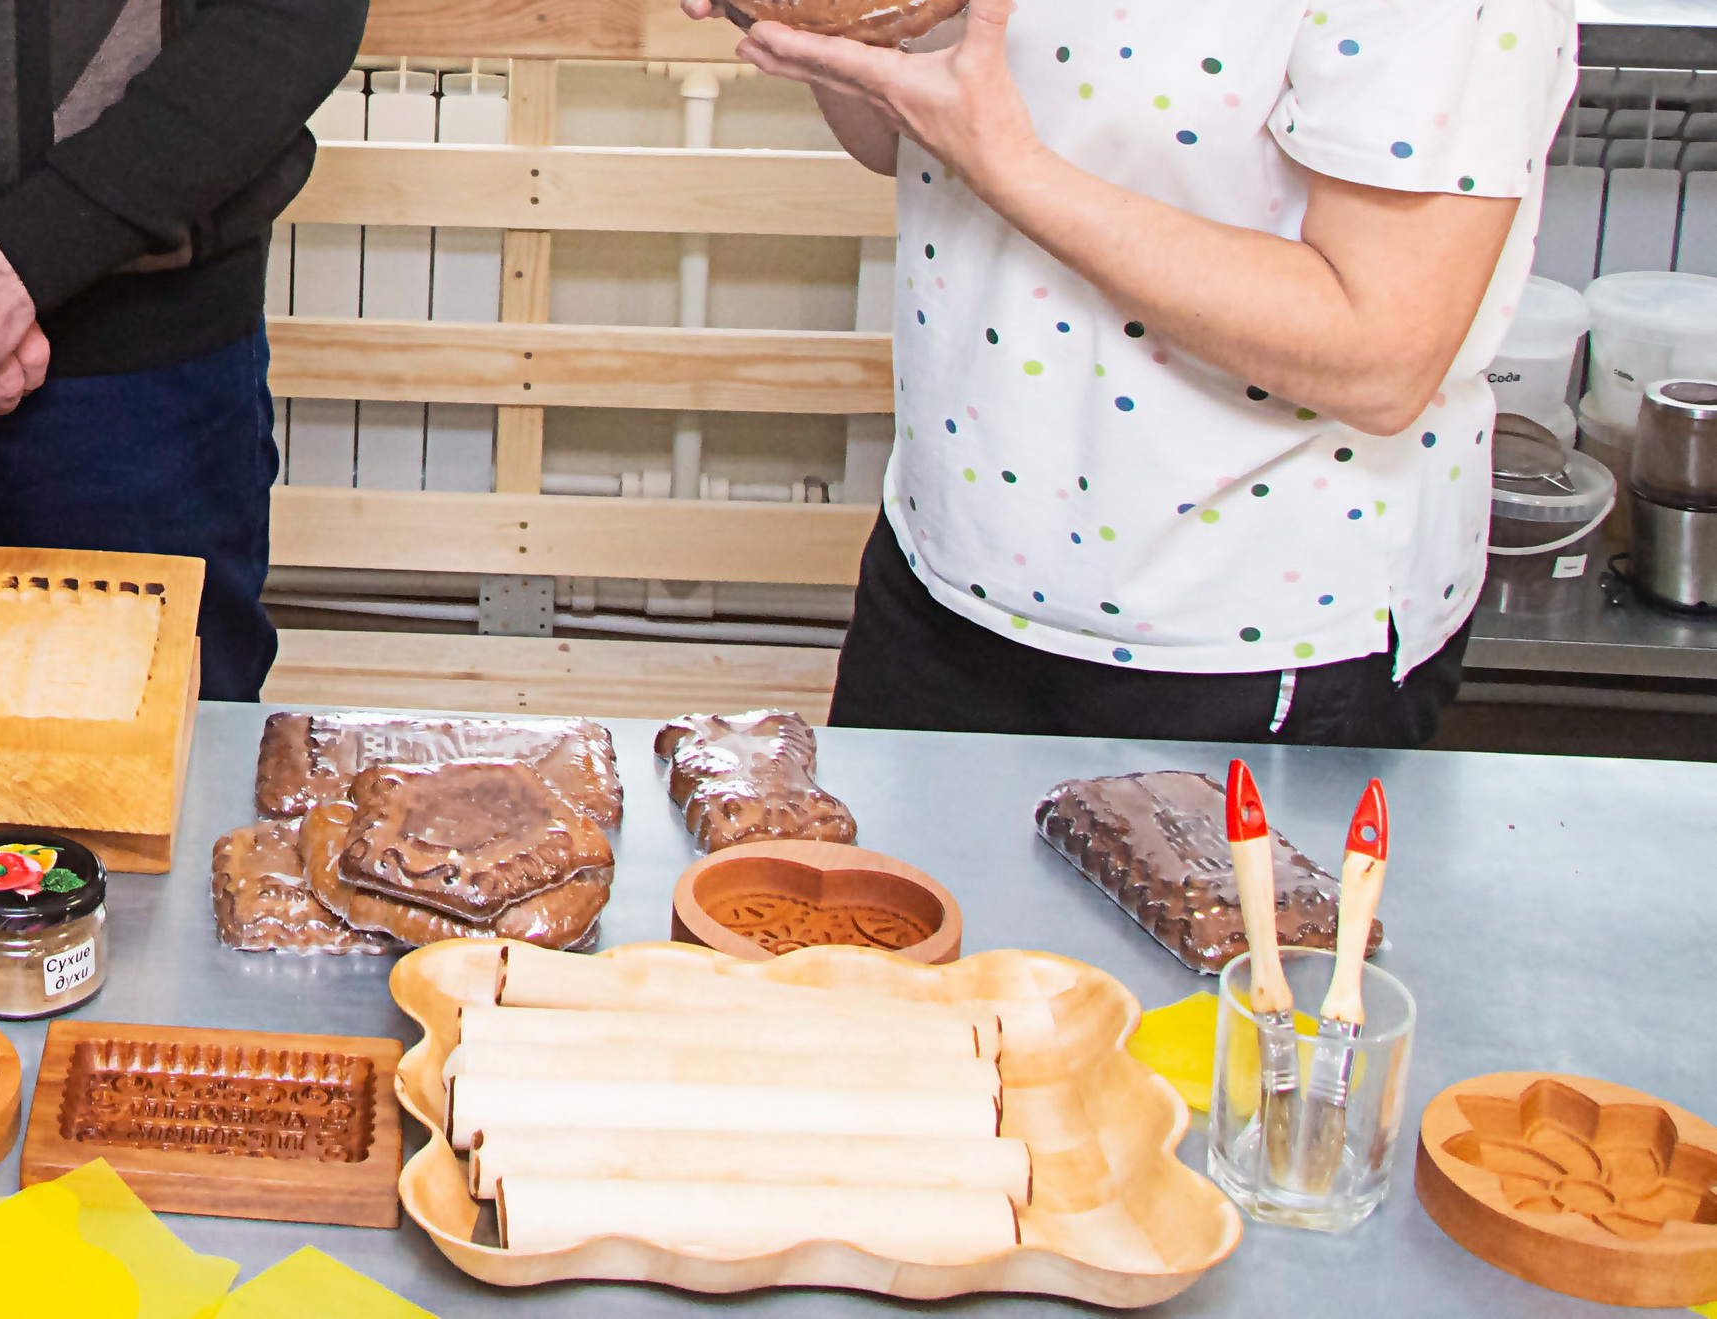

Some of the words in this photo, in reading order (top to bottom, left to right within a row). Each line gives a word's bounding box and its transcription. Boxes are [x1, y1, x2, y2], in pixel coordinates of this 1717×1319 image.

[1487, 371, 1521, 383] Сода
[46, 946, 90, 973] Сухие
[55, 966, 89, 991] духи
